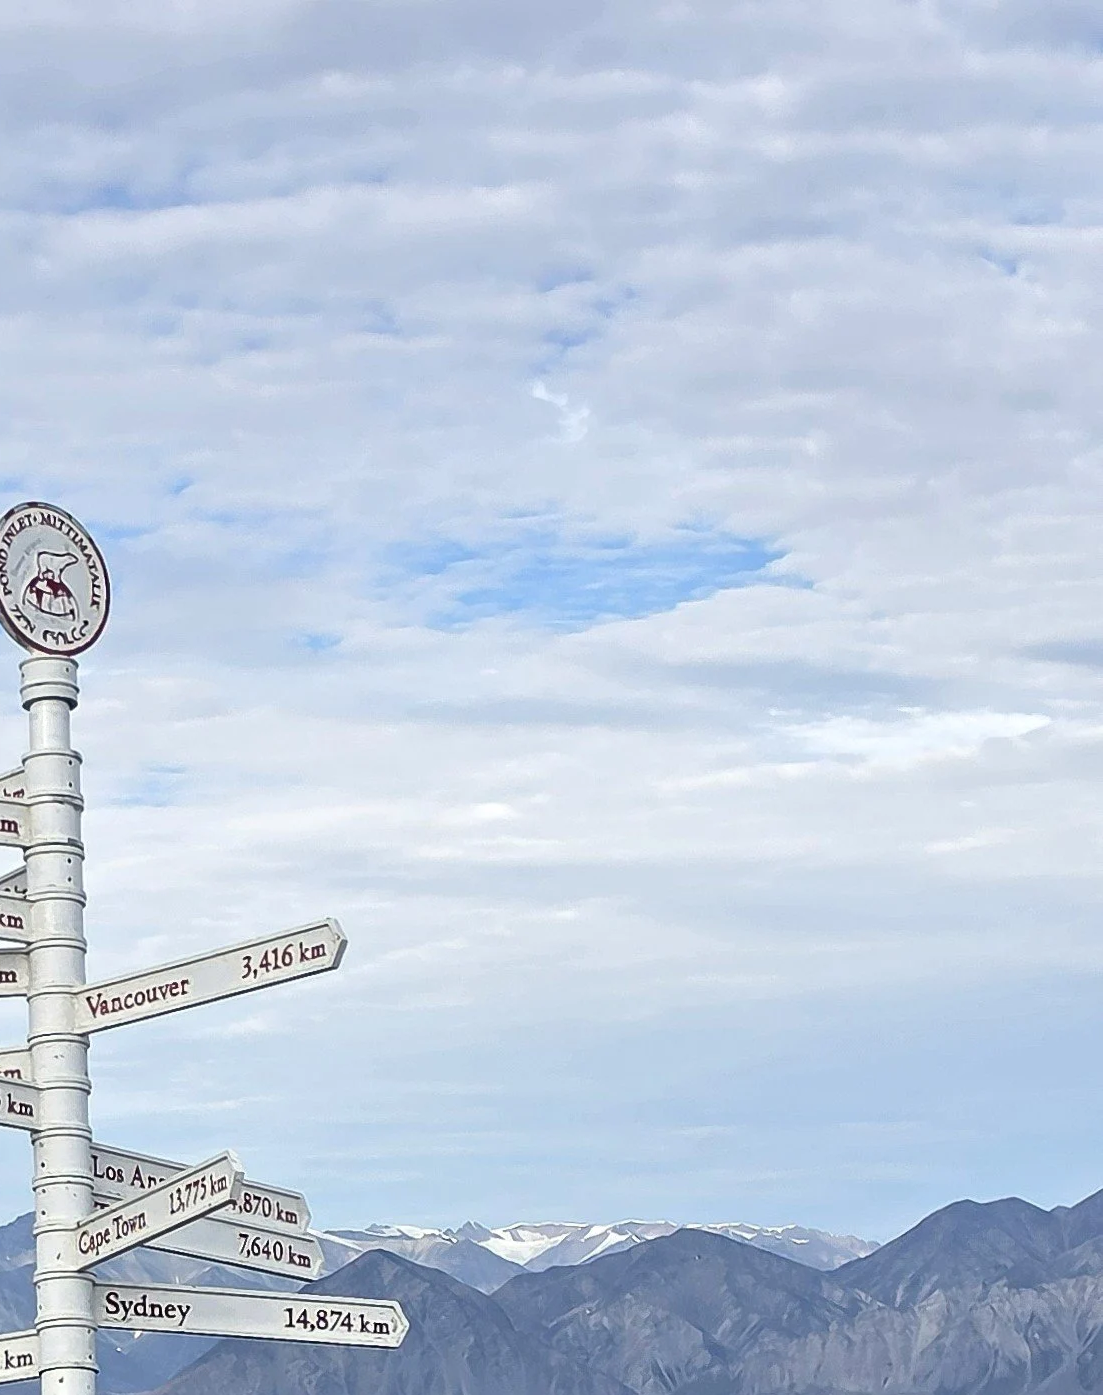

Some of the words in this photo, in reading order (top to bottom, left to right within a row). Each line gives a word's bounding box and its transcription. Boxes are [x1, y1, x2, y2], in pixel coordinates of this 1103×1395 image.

[2, 513, 33, 548] INLET
[86, 978, 190, 1018] Vancouver
[241, 944, 294, 979] 3,416
[299, 941, 327, 963] km
[7, 1093, 34, 1117] km
[91, 1155, 124, 1183] Los
[232, 1192, 272, 1218] ,870
[276, 1201, 298, 1224] km
[78, 1228, 110, 1256] Cape
[113, 1212, 146, 1240] Town
[169, 1176, 207, 1215] 13,775
[210, 1174, 228, 1196] km
[238, 1233, 284, 1262] 7,640
[288, 1245, 311, 1268] km
[105, 1292, 191, 1327] Sydney
[283, 1307, 355, 1332] 14,874
[360, 1314, 389, 1335] km
[4, 1350, 34, 1369] km
